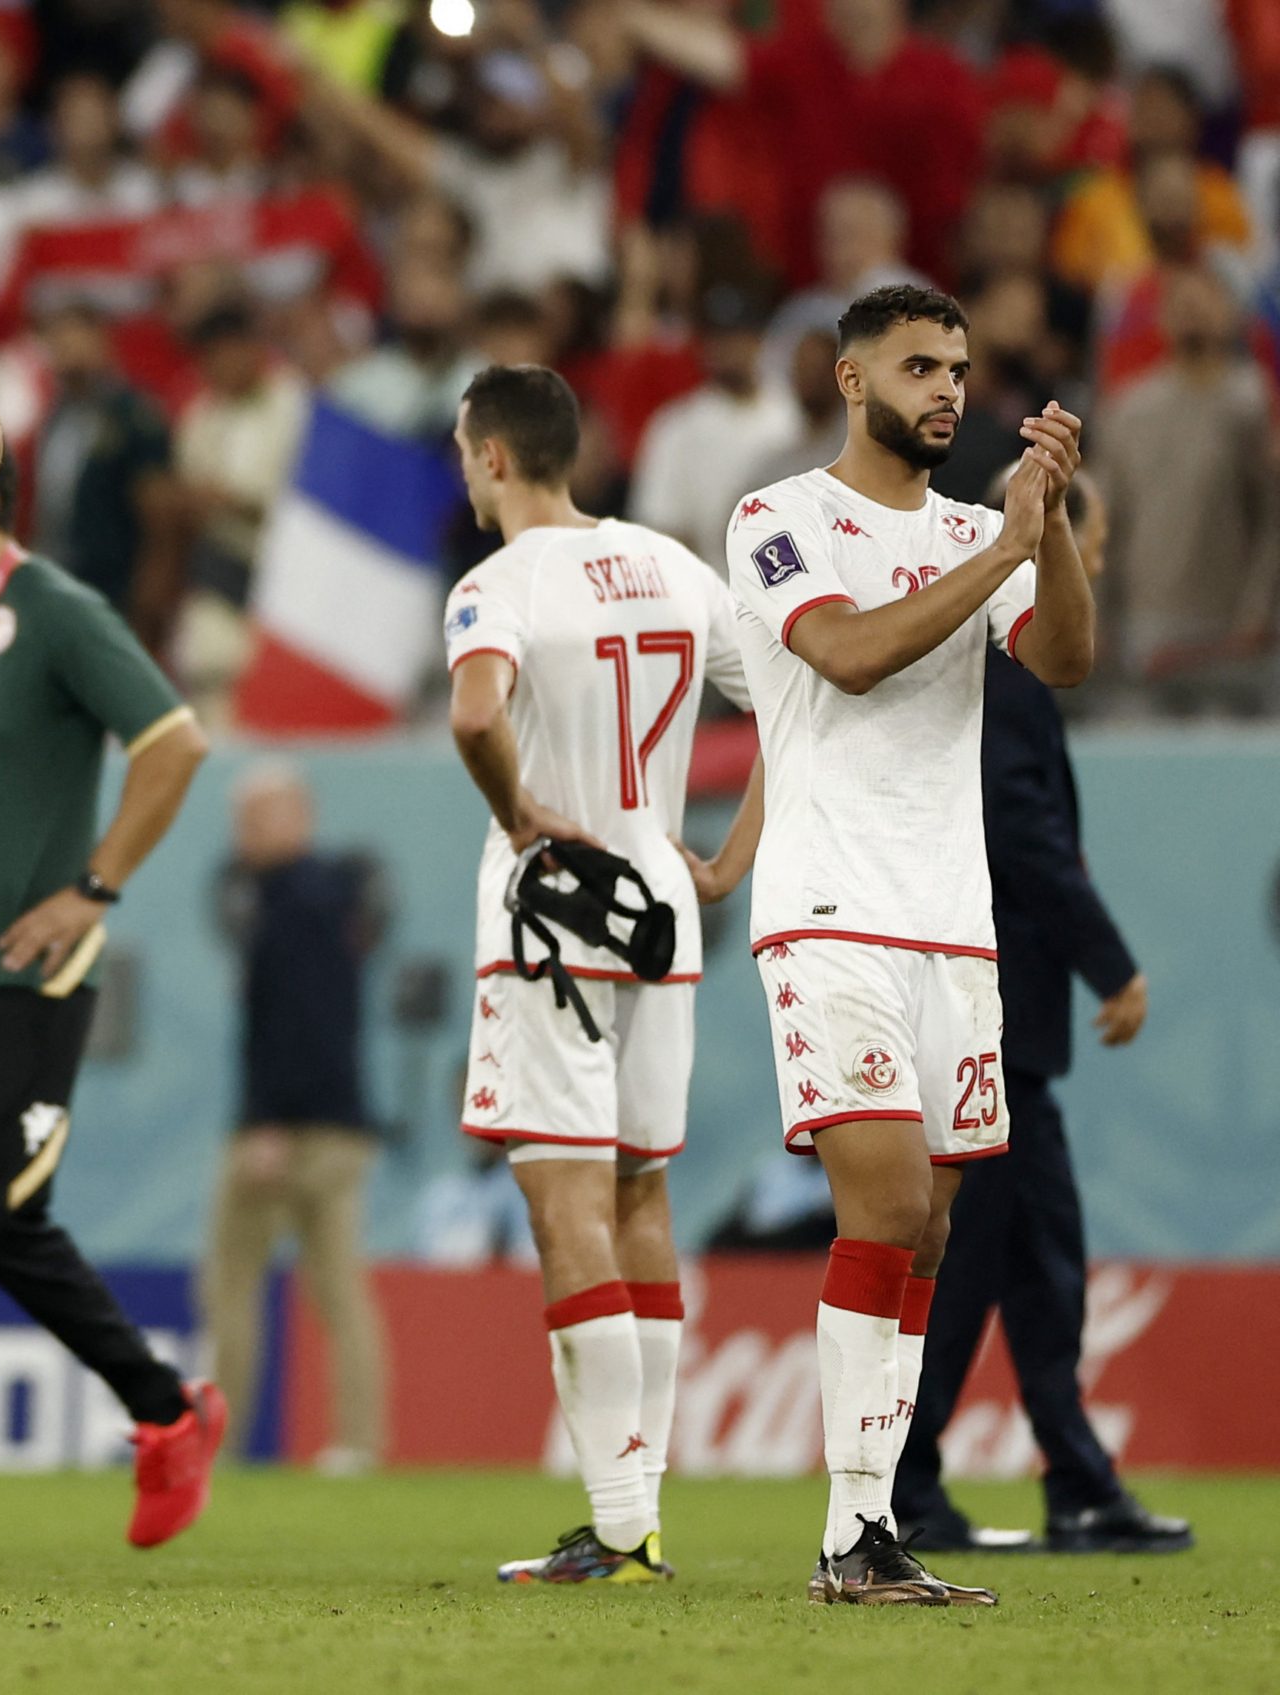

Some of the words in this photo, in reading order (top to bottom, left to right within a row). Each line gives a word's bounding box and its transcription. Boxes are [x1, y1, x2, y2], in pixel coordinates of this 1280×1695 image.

[595, 630, 694, 810] 17
[953, 1052, 998, 1130] 25
[860, 1414, 895, 1432] FTF
